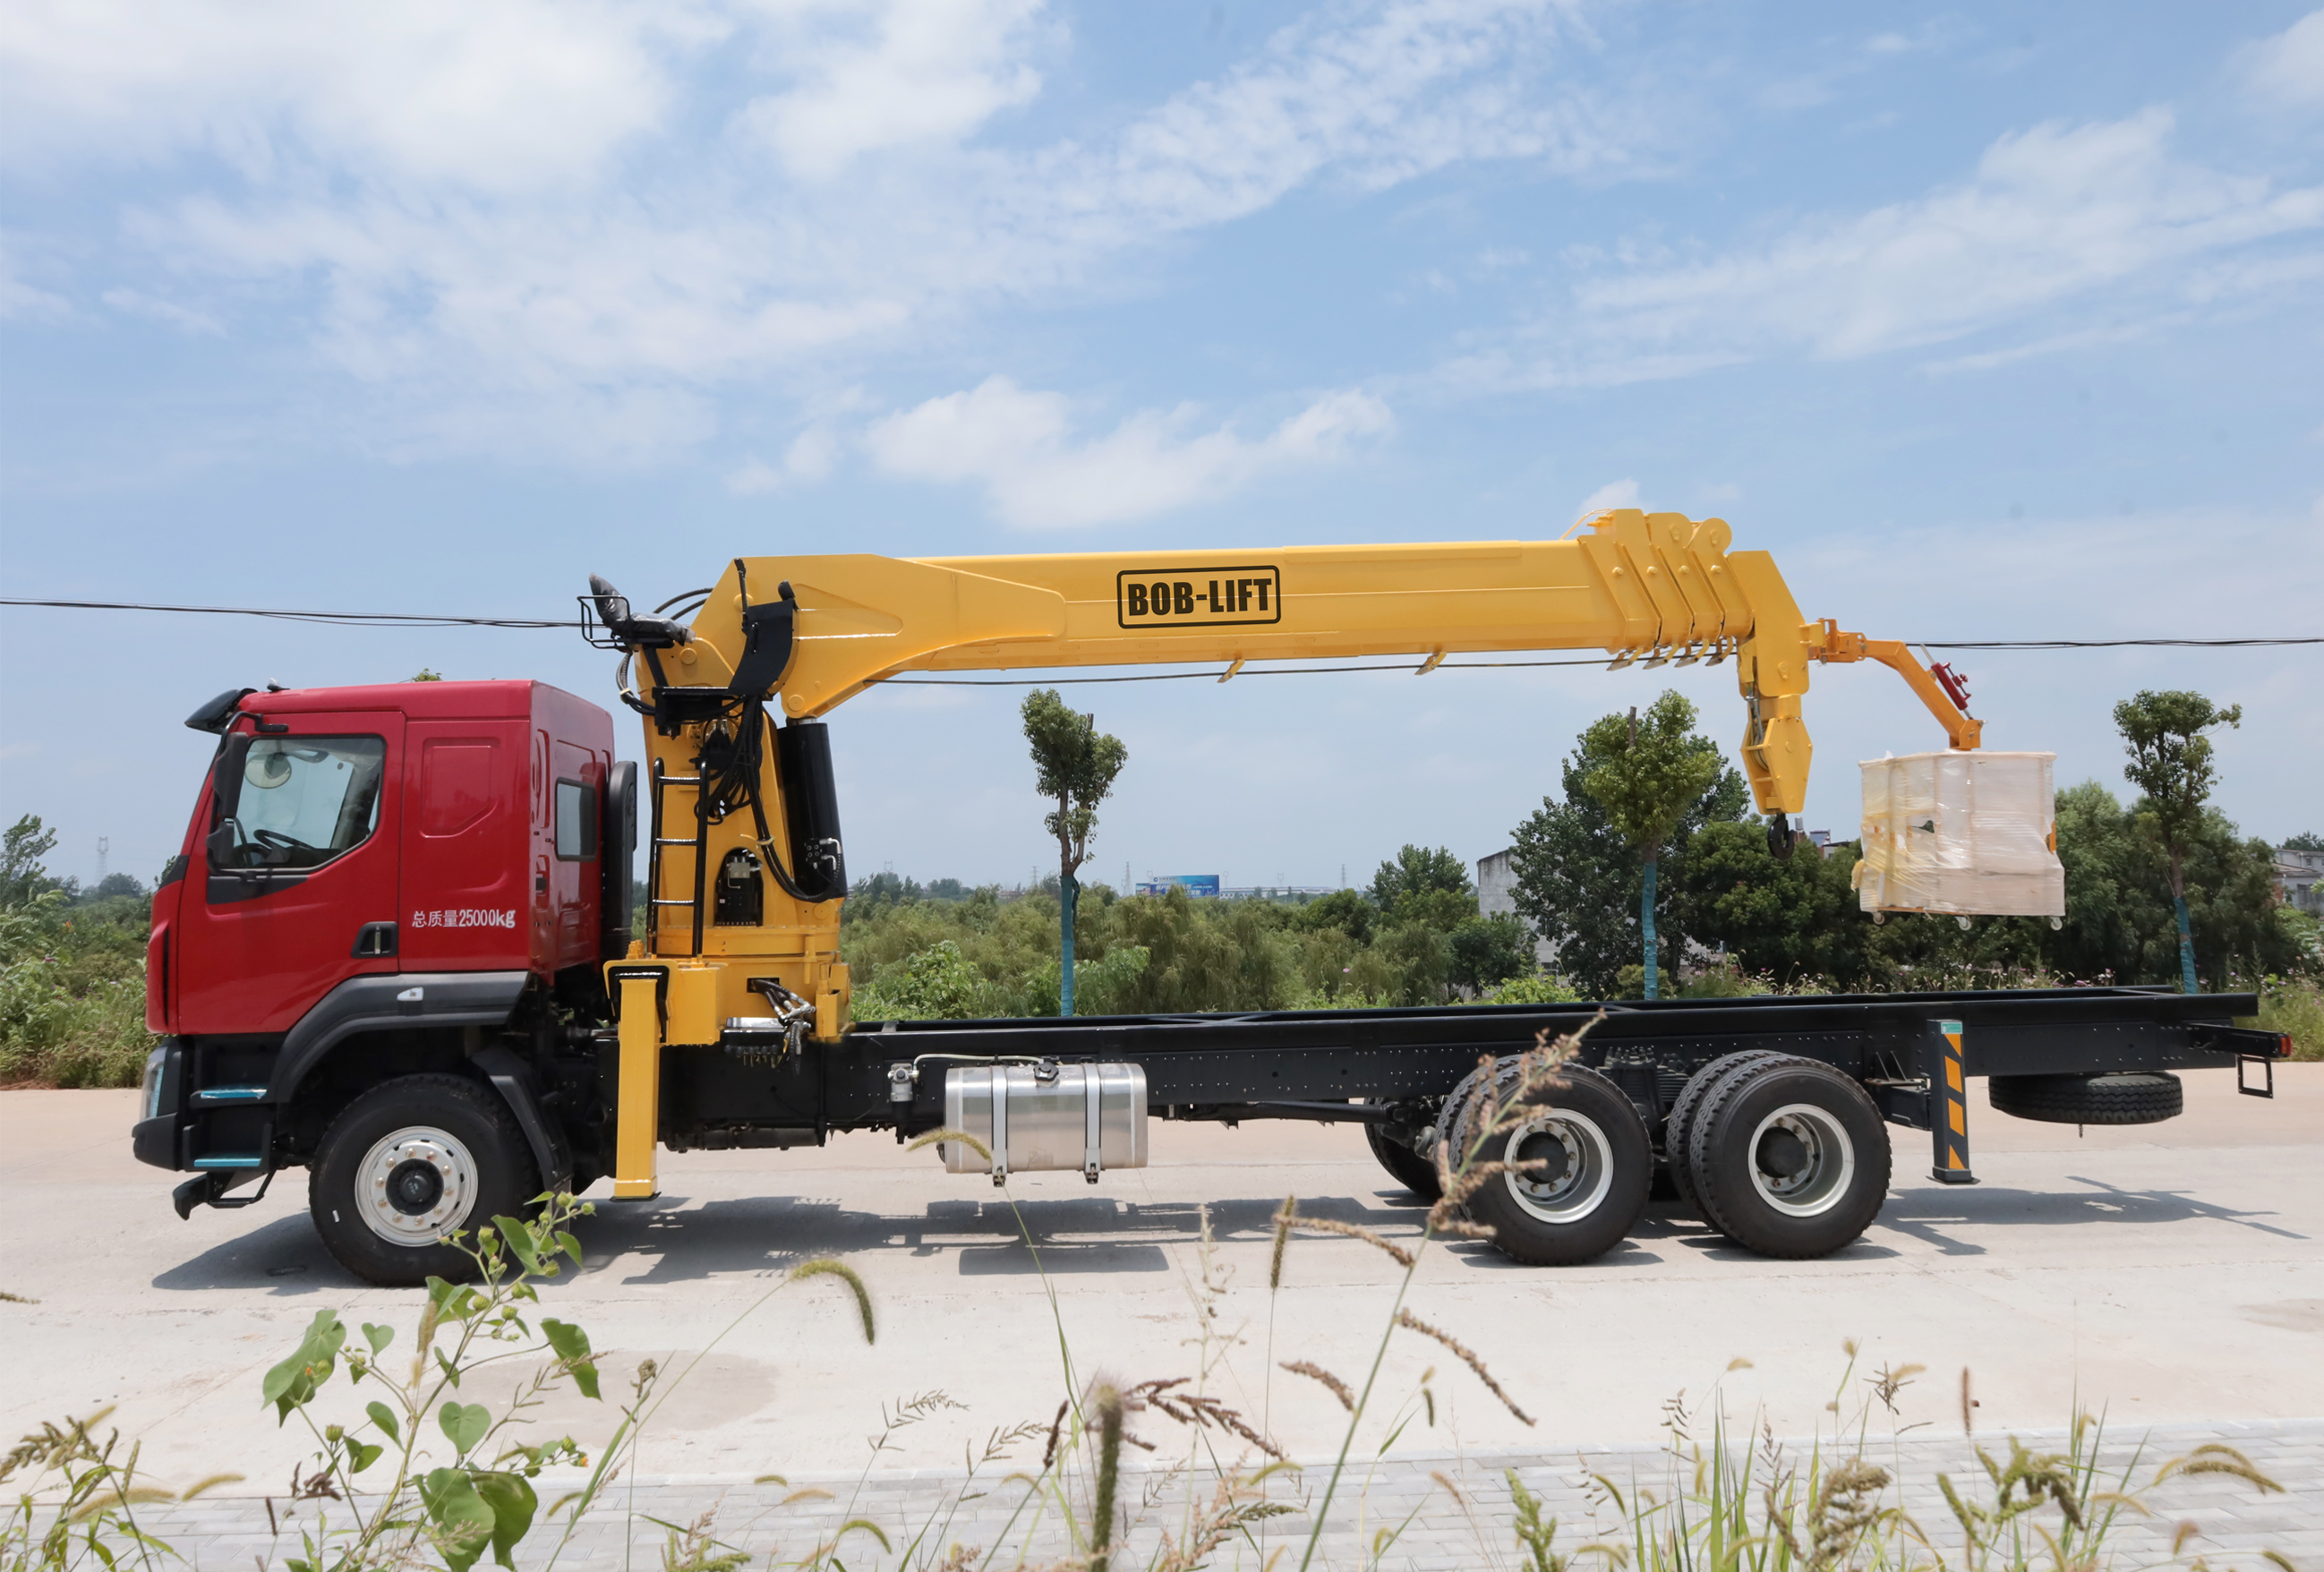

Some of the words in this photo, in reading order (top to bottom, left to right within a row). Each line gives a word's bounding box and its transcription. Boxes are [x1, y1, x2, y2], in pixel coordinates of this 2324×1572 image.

[1127, 577, 1272, 617] BOB-LIFT
[412, 909, 516, 928] 总质量25000kg
